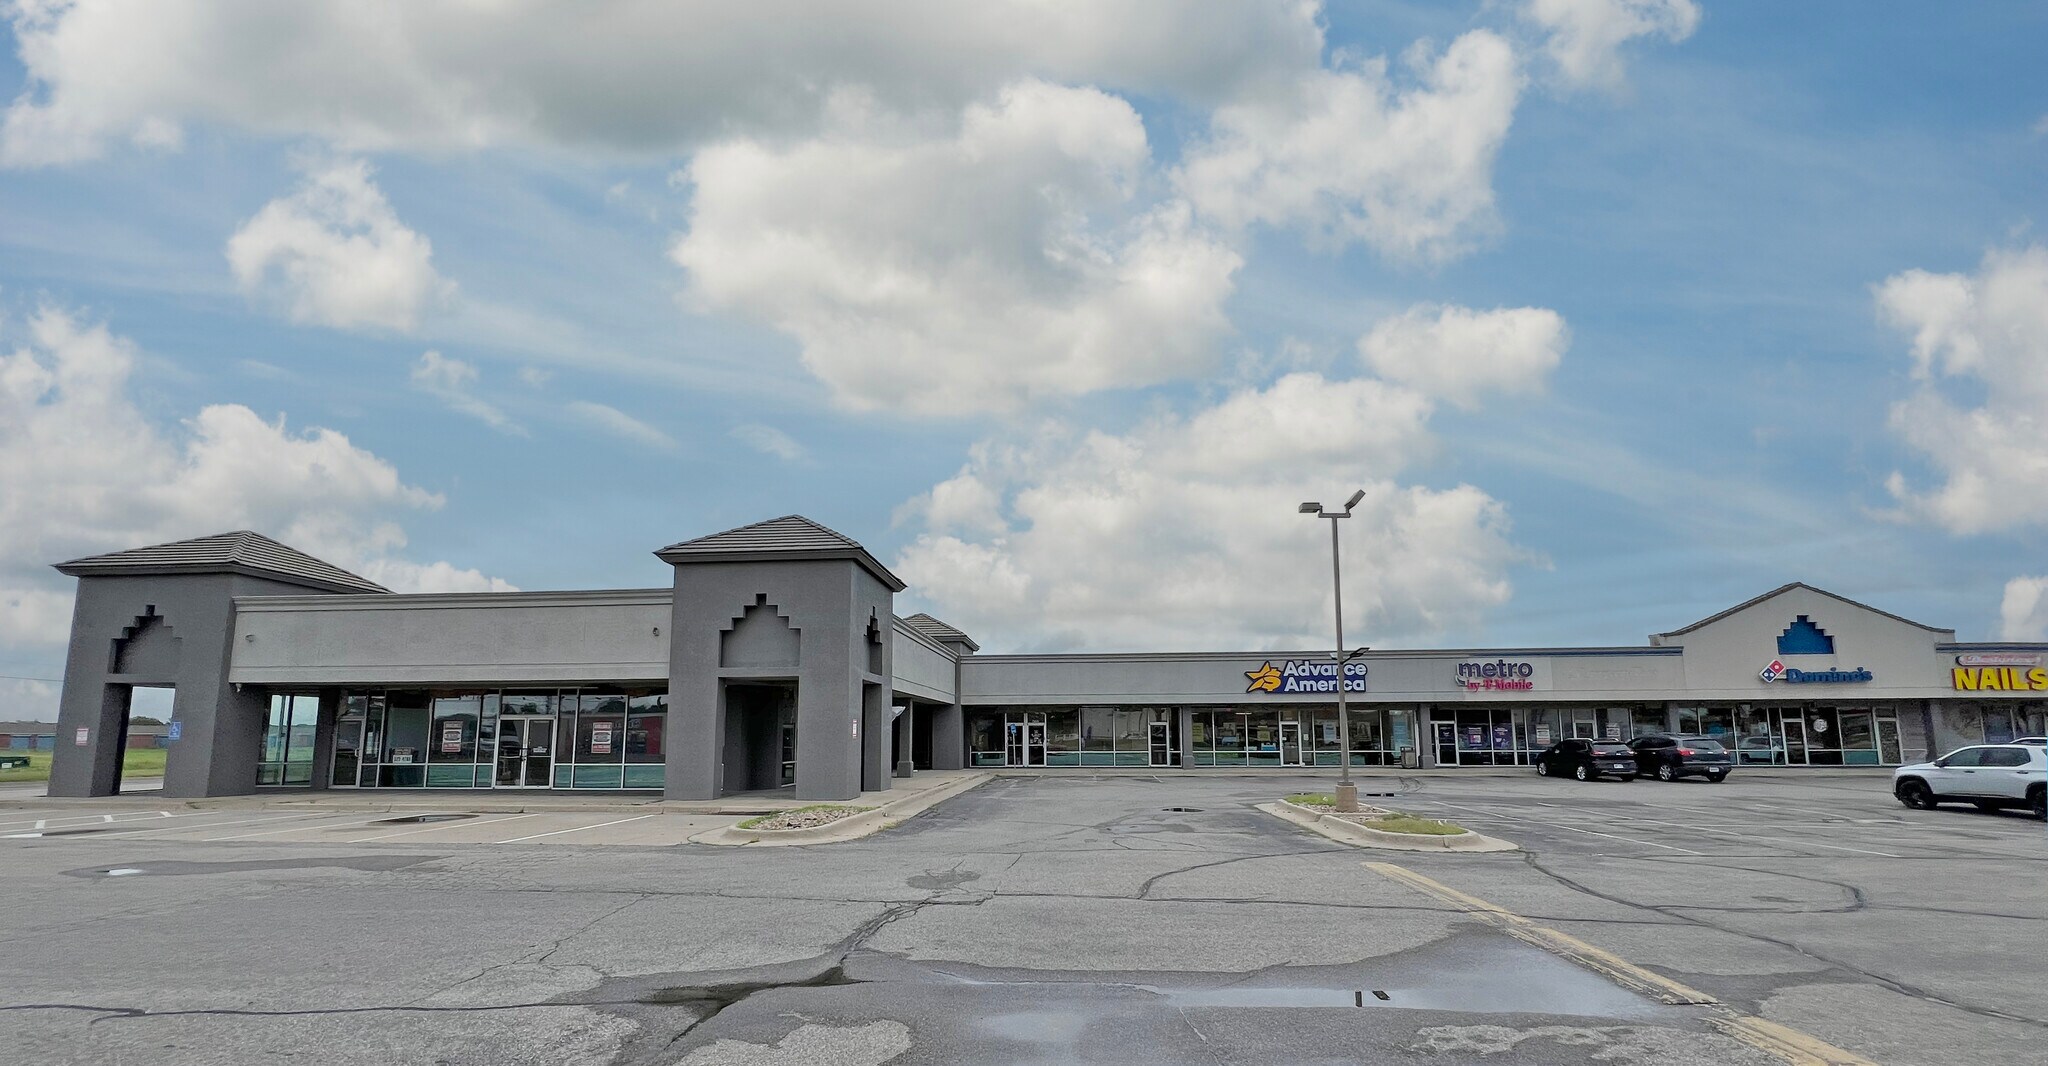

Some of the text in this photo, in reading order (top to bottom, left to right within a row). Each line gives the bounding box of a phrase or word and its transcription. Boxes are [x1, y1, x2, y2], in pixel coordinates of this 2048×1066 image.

[1458, 659, 1533, 678] metro
[1786, 667, 1873, 682] Domino's
[1953, 667, 2048, 690] NAILS
